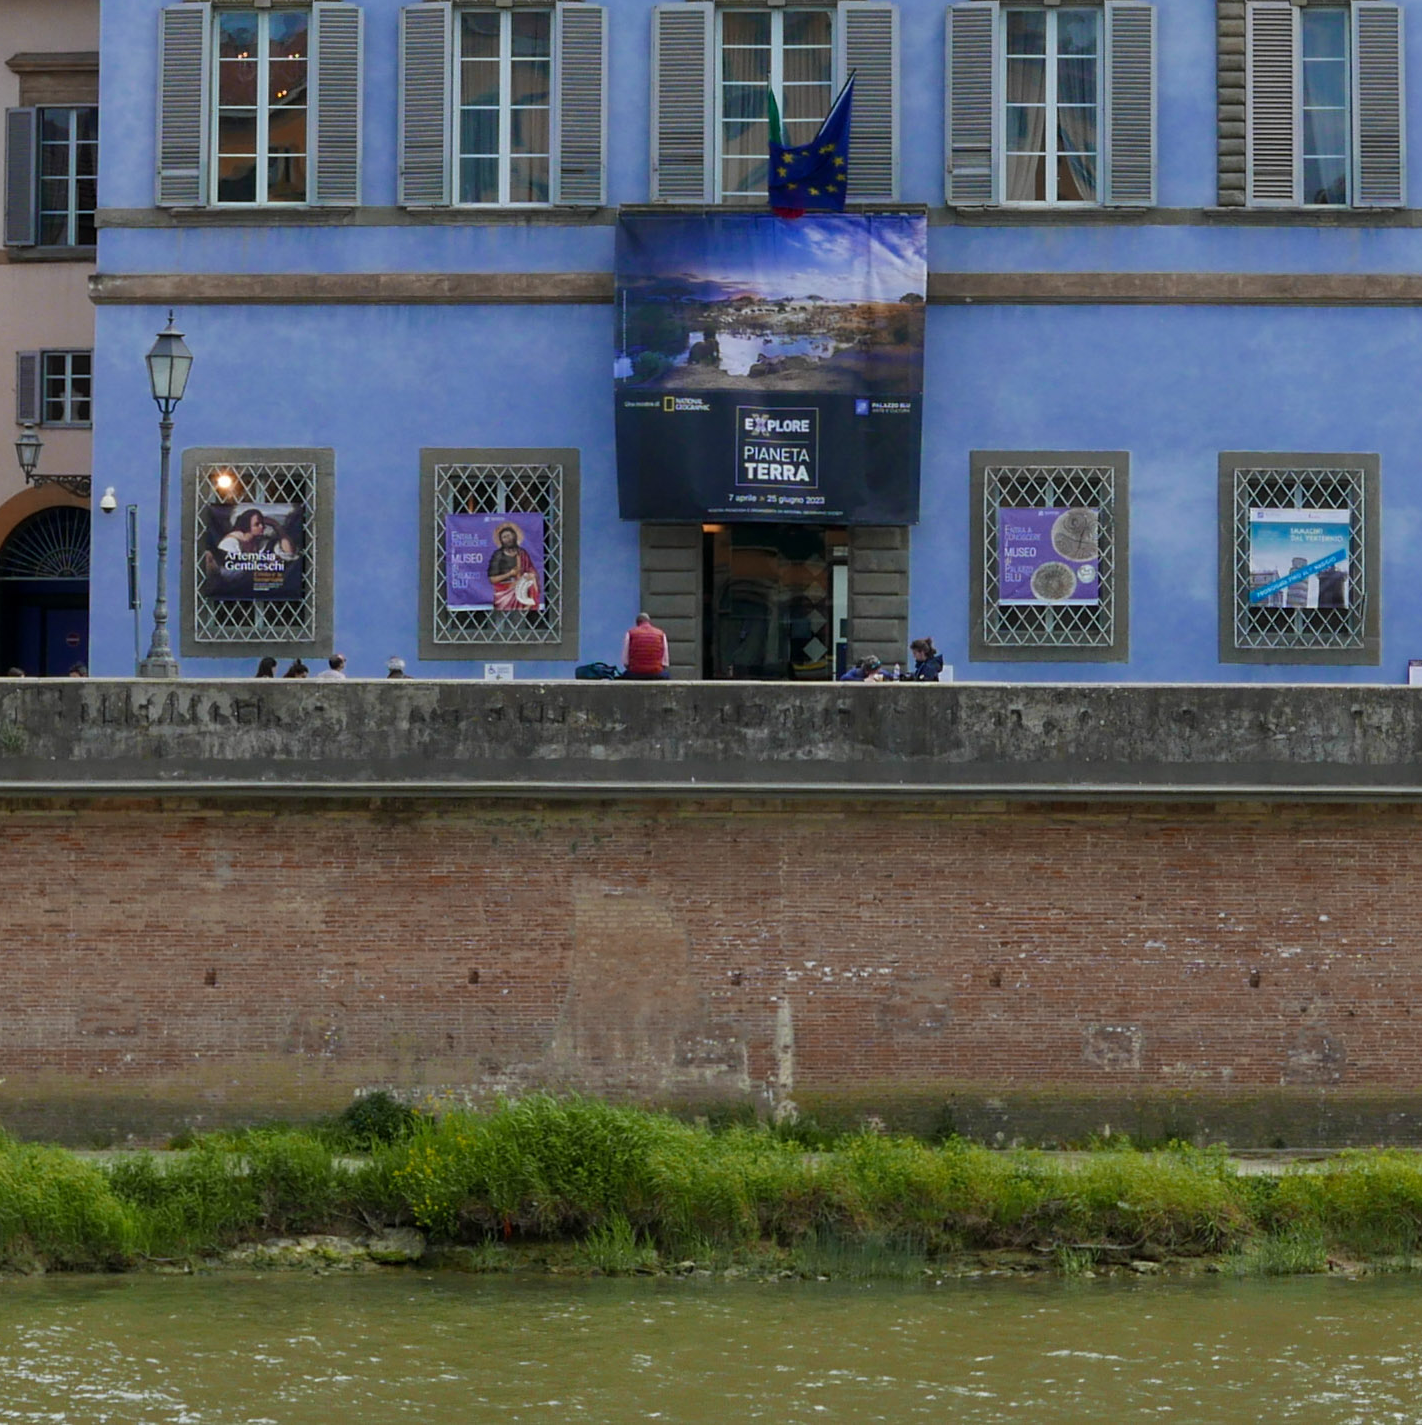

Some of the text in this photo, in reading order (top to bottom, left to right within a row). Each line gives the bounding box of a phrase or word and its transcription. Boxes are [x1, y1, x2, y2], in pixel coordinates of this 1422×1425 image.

[744, 413, 810, 436] EXPLORE
[744, 446, 810, 463] PIANETA
[744, 463, 810, 482] TERRA
[735, 494, 757, 502] aprile
[778, 495, 804, 505] giugno
[225, 550, 276, 561] Artemisia
[1004, 547, 1037, 557] MUSEO
[451, 553, 483, 563] MUSEO
[225, 560, 285, 571] Gentileschi
[1005, 573, 1022, 582] BLU
[452, 579, 468, 588] BLU
